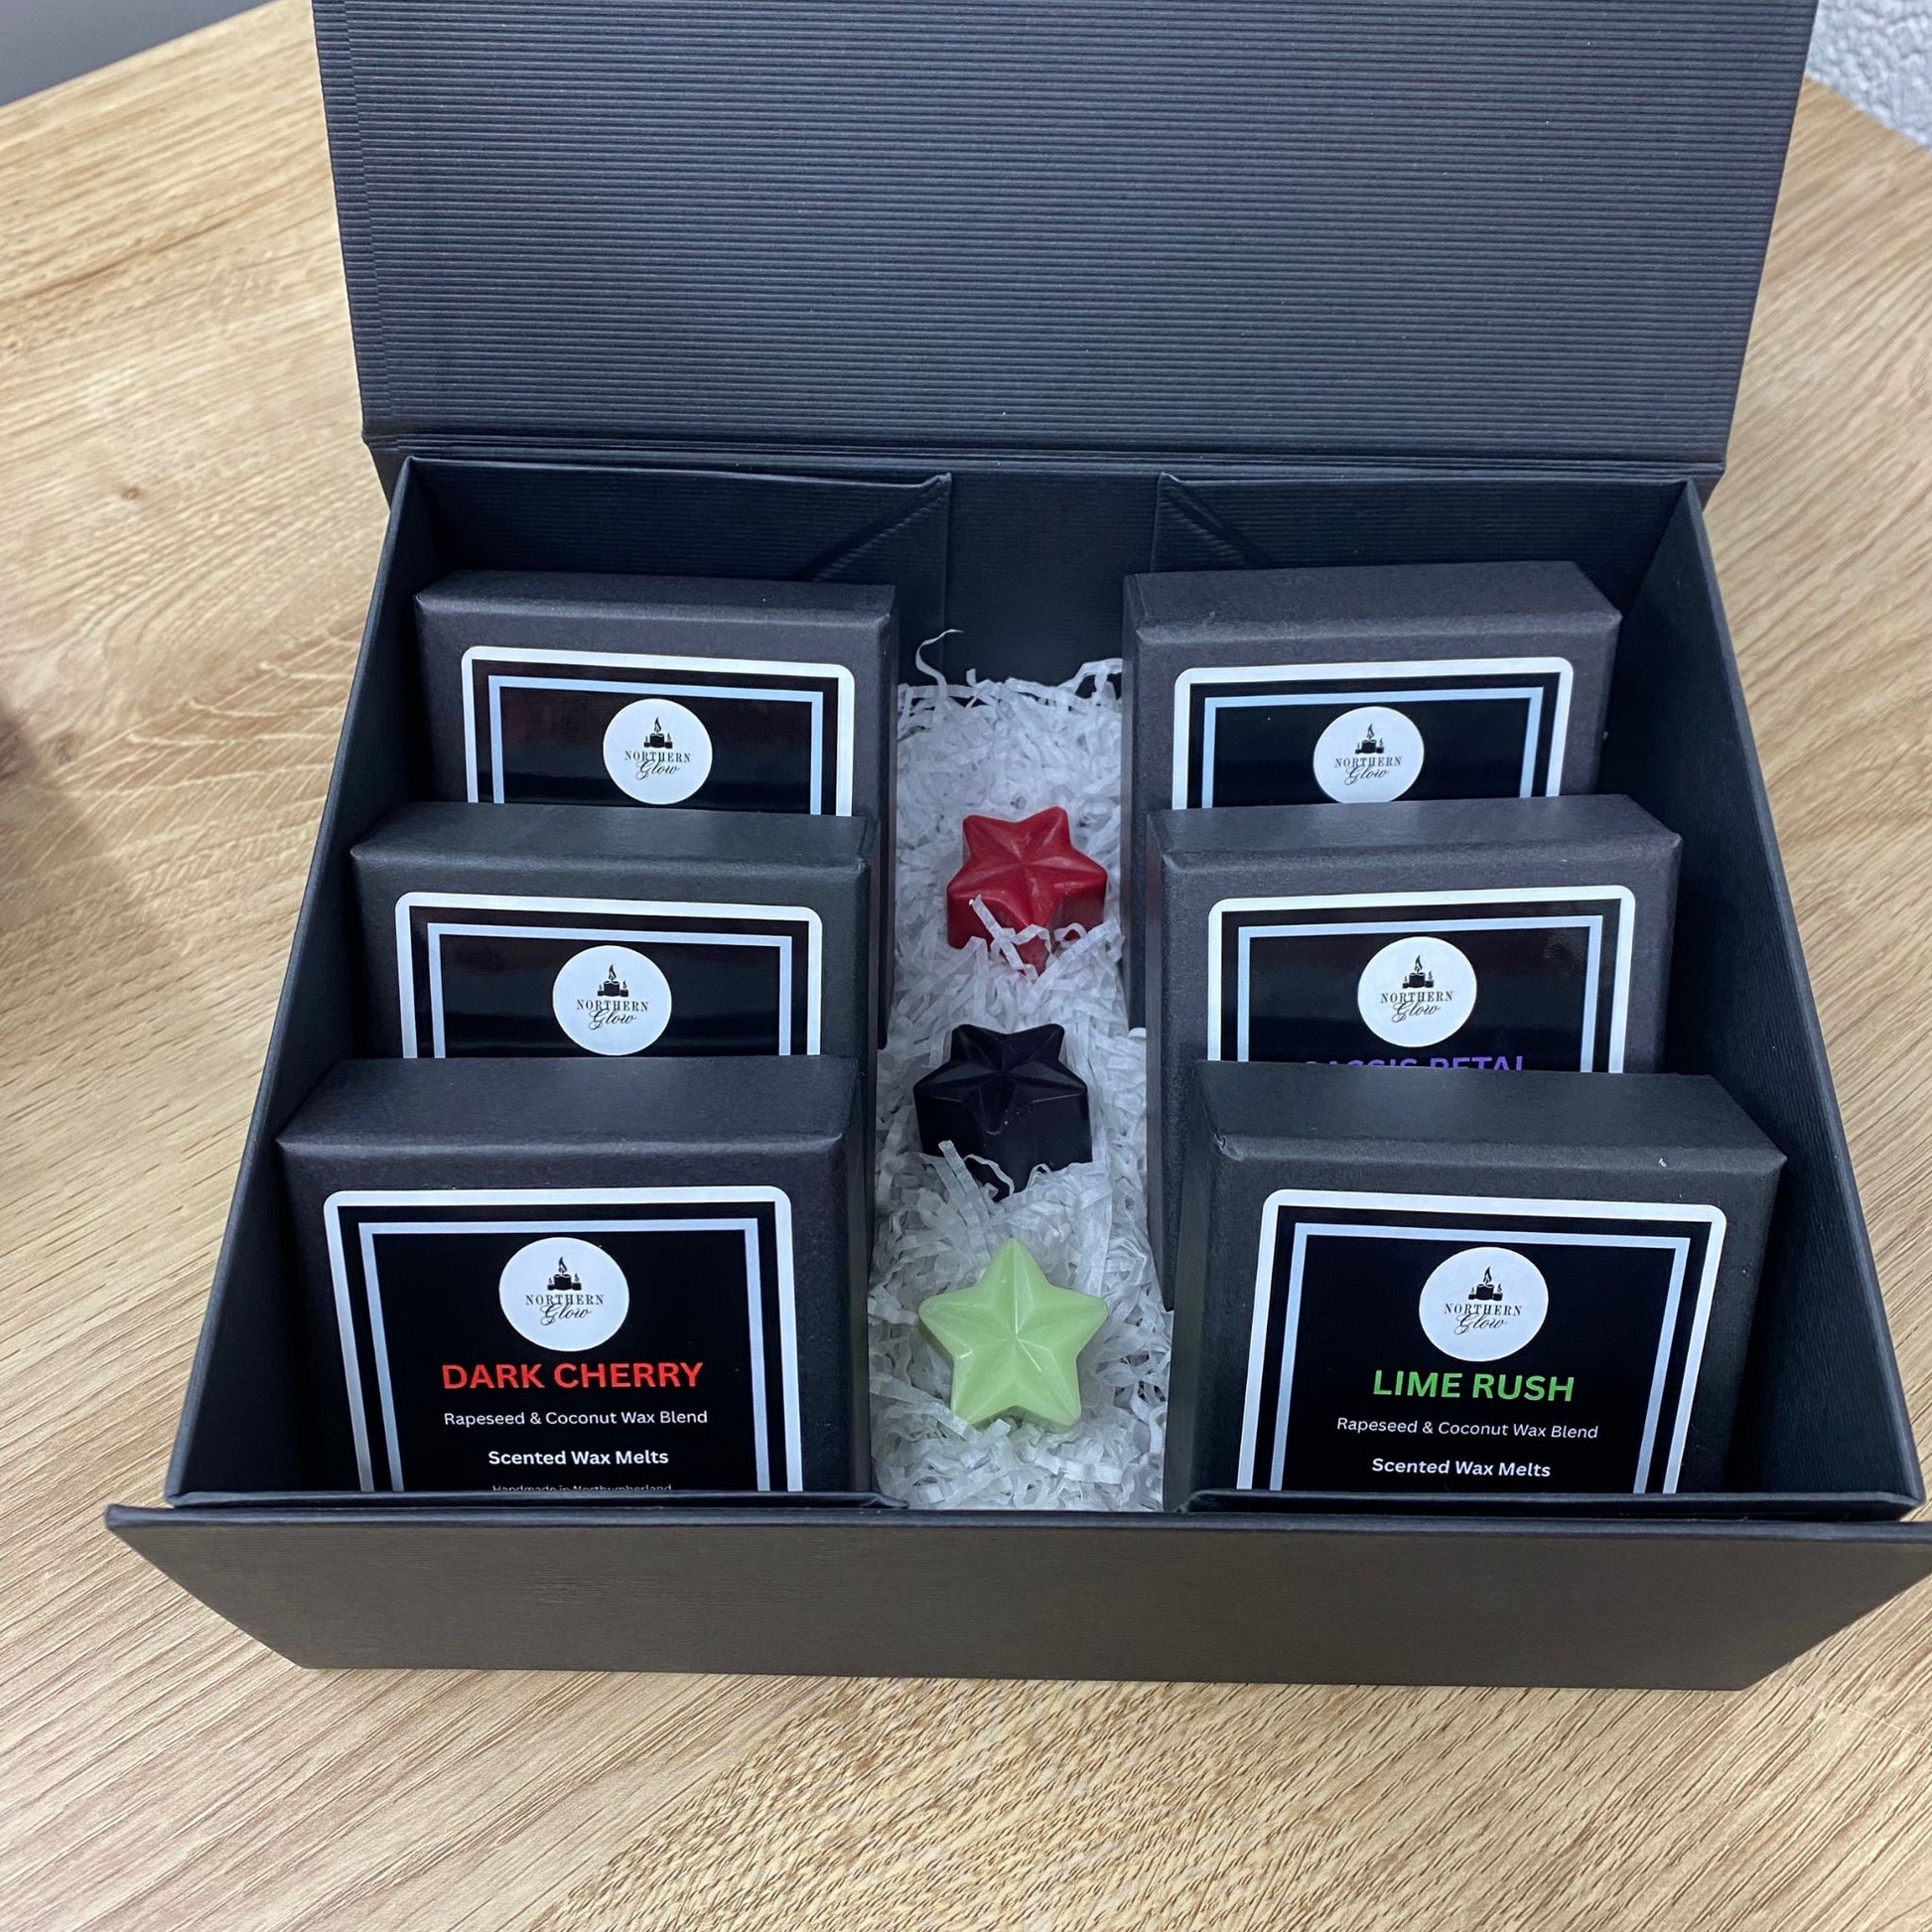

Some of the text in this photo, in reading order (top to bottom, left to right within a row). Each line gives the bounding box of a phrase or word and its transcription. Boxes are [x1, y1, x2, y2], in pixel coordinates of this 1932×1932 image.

[624, 750, 691, 763] NORTHERN
[1334, 757, 1403, 768] NORTHERN
[635, 759, 681, 780] Glow
[1344, 763, 1390, 785] Glow
[577, 999, 649, 1013] NORTHERN
[1381, 991, 1453, 1005] NORTHERN
[589, 1008, 637, 1031] Glow
[1392, 1001, 1441, 1023] Glow
[525, 1294, 605, 1306] NORTHERN
[1444, 1303, 1523, 1316] NORTHERN
[539, 1303, 593, 1325] Glow
[1453, 1312, 1509, 1335] Glow
[442, 1361, 704, 1390] DARK CHERRY
[1373, 1369, 1575, 1402] LIME RUSH
[444, 1410, 708, 1429] Rapeseed & Coconut Wax Blend
[1336, 1417, 1599, 1440] Rapeseed & Coconut Wax Blend
[487, 1449, 669, 1465] Scented Wax Melts
[1371, 1457, 1551, 1477] Scented Wax Melts
